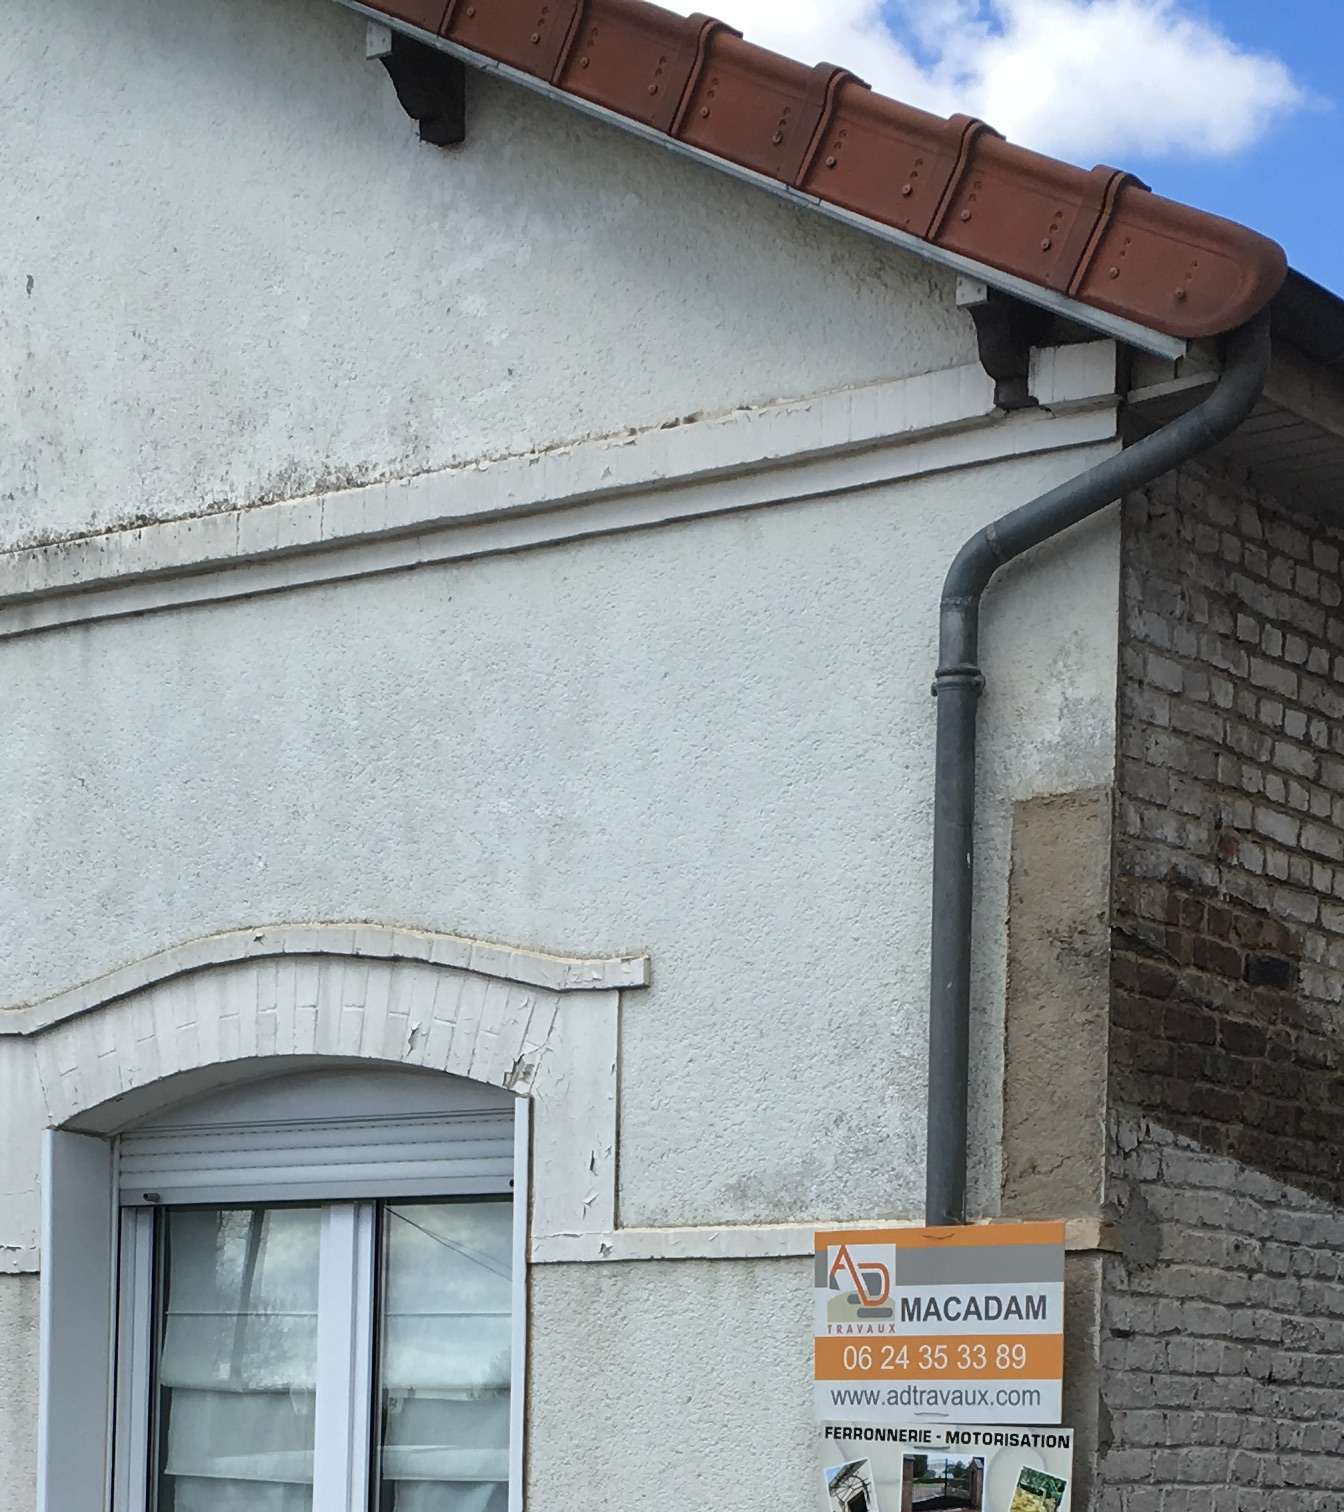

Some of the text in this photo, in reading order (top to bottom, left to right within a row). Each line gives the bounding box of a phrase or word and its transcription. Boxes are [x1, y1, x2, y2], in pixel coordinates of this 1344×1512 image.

[900, 1295, 1047, 1322] MACADAM
[827, 1323, 896, 1334] TRAVAUX
[843, 1344, 1027, 1370] 06 24 35 33 89
[831, 1384, 1041, 1406] www.adtravaux.com
[824, 1426, 931, 1443] FERRONNERIE
[946, 1431, 1070, 1449] MOTORISATION
